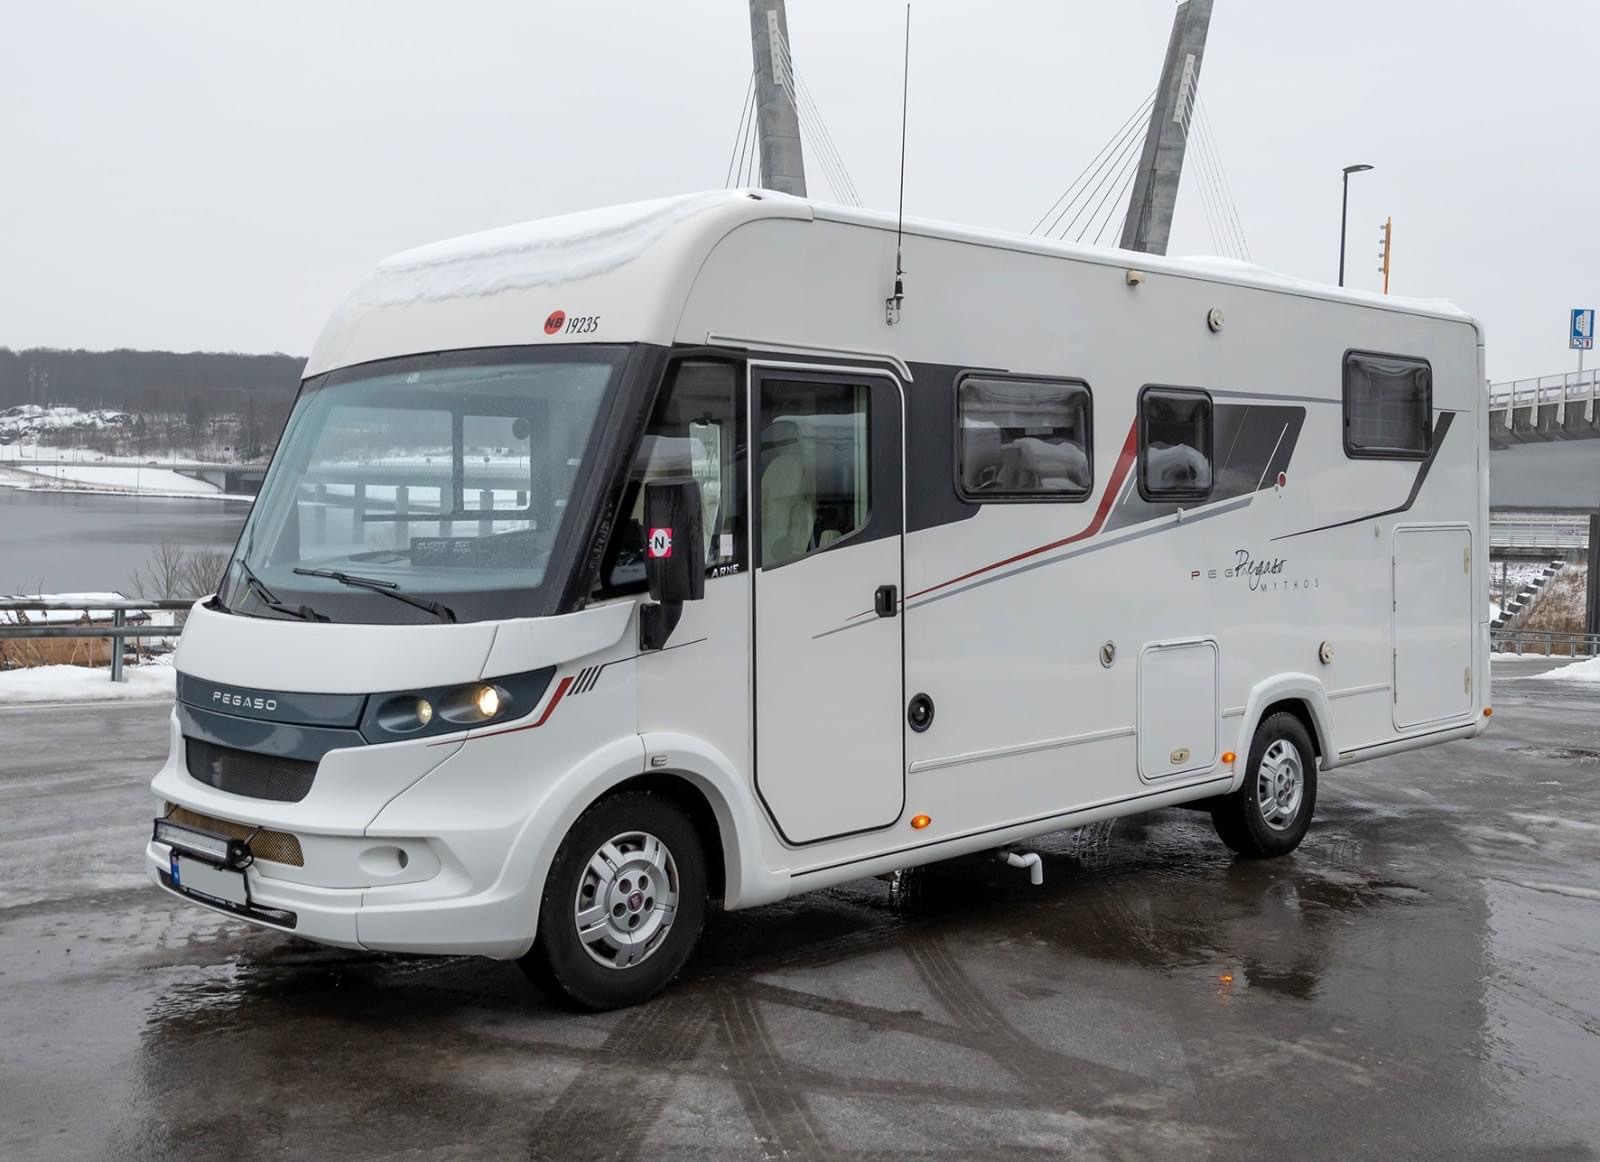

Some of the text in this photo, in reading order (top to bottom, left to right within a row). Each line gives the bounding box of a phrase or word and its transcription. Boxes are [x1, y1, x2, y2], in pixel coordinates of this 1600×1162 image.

[565, 316, 600, 334] 19235
[654, 536, 665, 549] N
[712, 564, 739, 578] ARNE
[1261, 578, 1320, 592] MYTHOS
[212, 691, 277, 711] PEGASO
